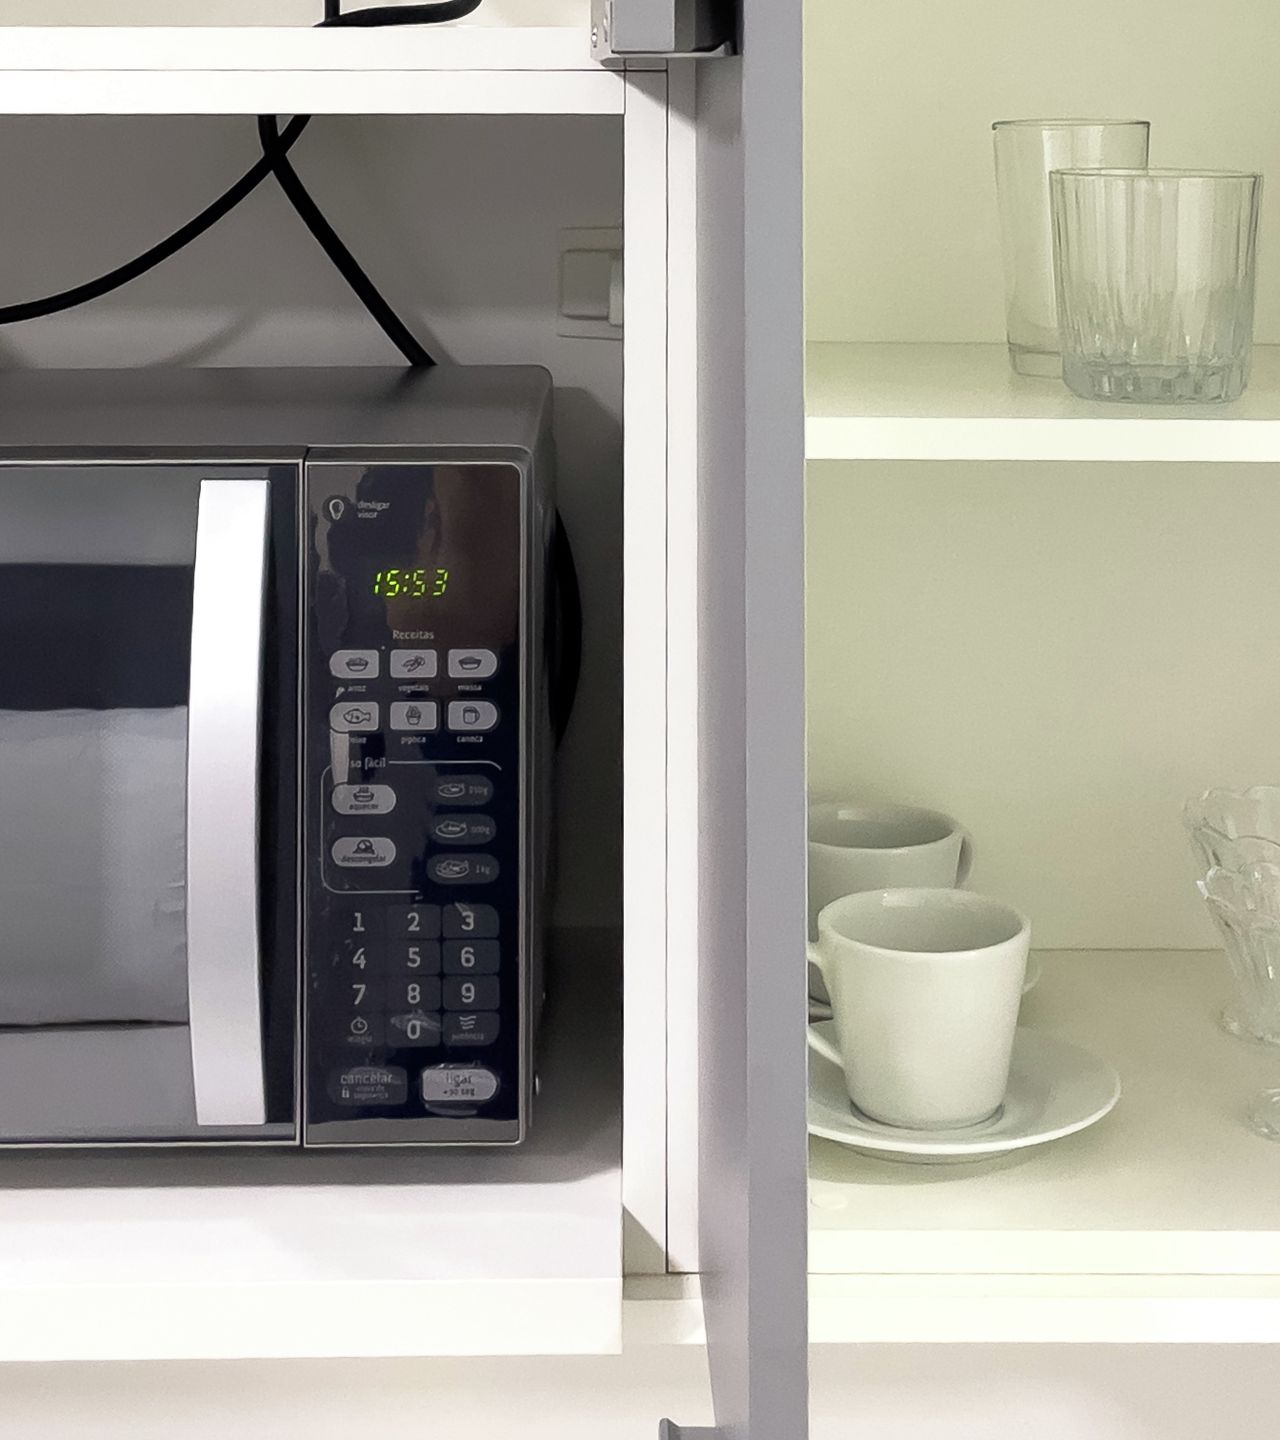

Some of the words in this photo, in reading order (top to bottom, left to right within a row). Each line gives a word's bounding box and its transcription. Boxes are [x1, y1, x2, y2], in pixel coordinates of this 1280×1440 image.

[374, 568, 449, 597] 15:53
[392, 629, 435, 640] Receitas
[353, 912, 365, 932] 1
[407, 912, 420, 932] 2
[461, 911, 475, 931] 3
[352, 947, 366, 969] 4
[407, 947, 420, 968] 5
[461, 947, 475, 967] 6
[352, 984, 366, 1005] 7
[407, 984, 420, 1004] 8
[461, 983, 475, 1003] 9
[407, 1020, 421, 1039] 0
[340, 1071, 393, 1085] cancelar
